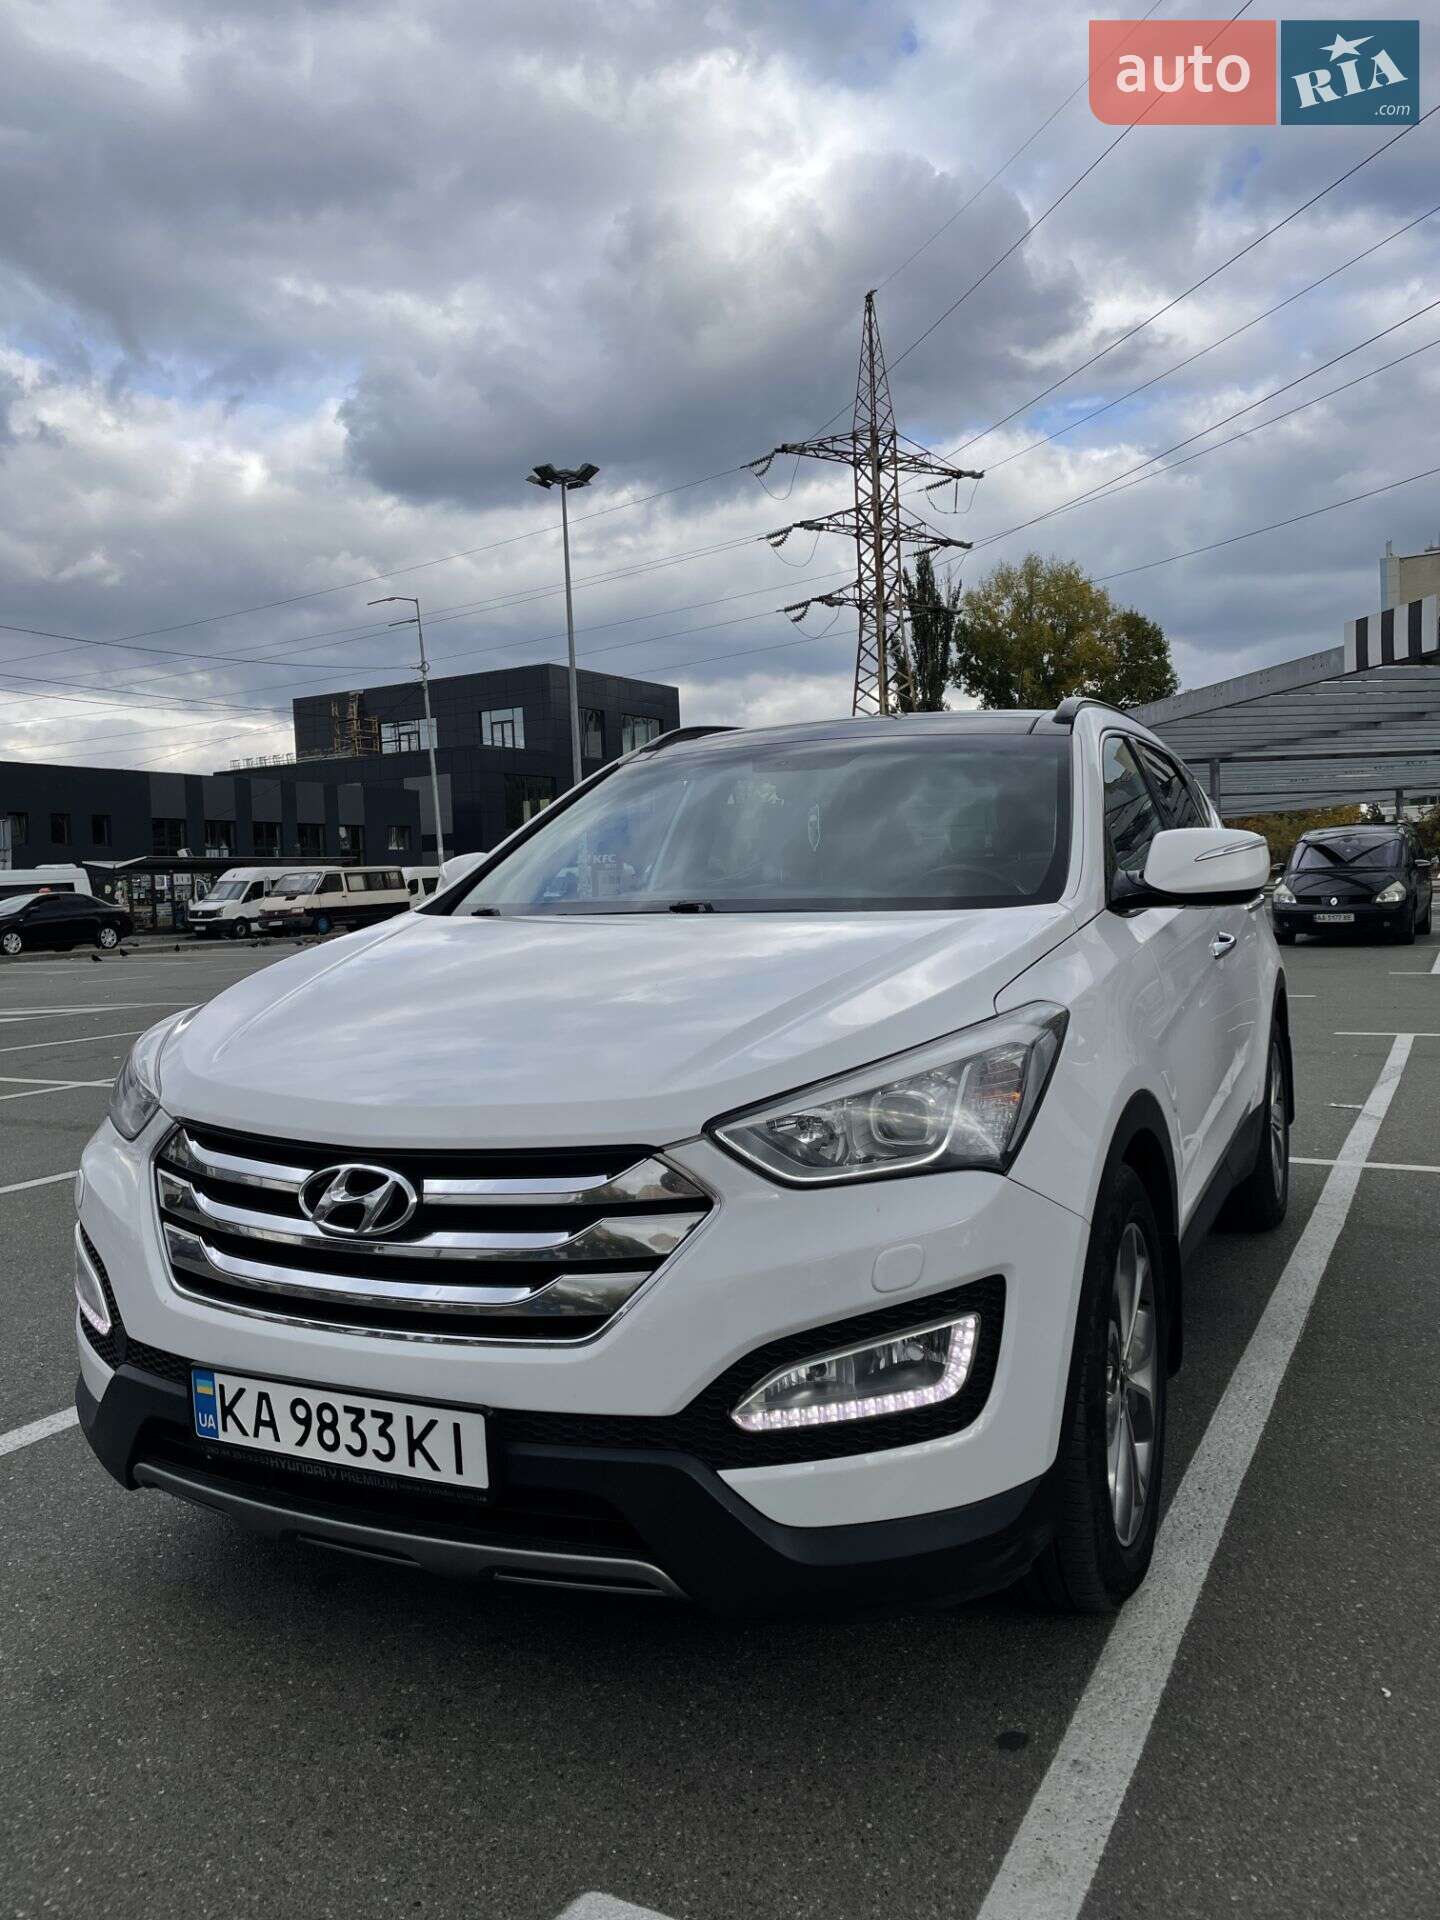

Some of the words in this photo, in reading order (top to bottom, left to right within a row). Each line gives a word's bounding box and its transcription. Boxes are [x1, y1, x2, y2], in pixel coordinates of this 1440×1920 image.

[593, 854, 616, 863] KFC
[199, 1412, 216, 1430] UA
[218, 1384, 281, 1442] KA
[289, 1397, 396, 1463] 9833
[405, 1415, 464, 1475] KI
